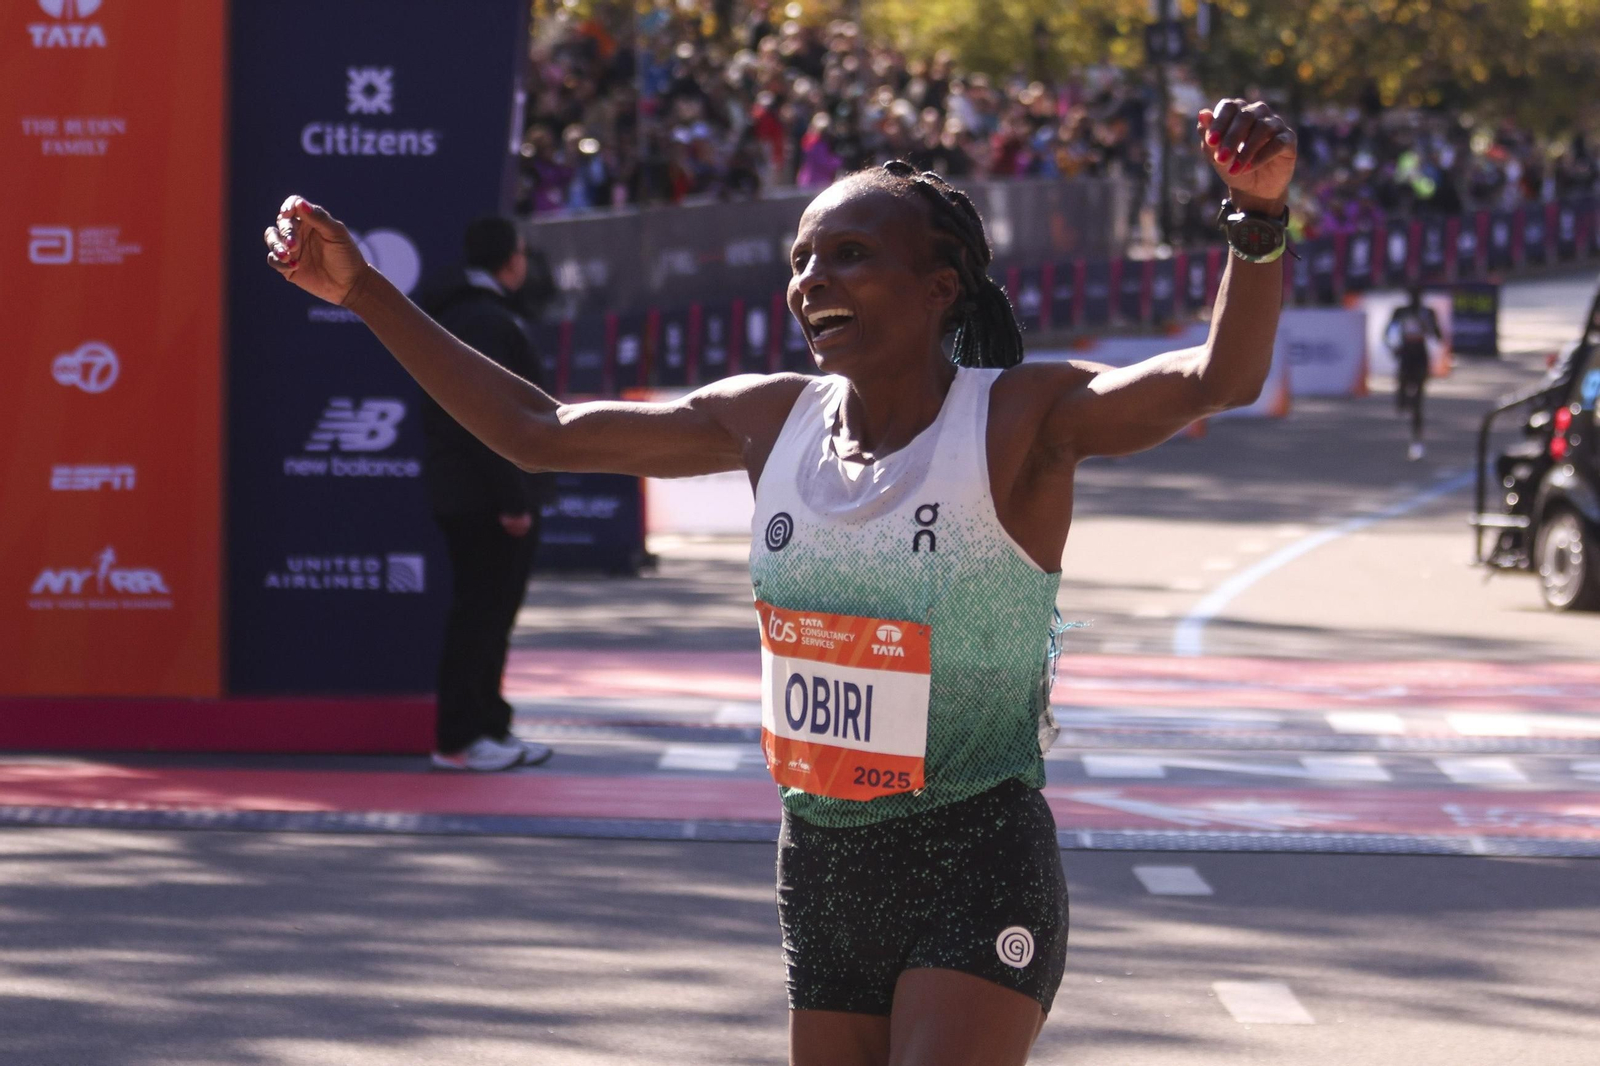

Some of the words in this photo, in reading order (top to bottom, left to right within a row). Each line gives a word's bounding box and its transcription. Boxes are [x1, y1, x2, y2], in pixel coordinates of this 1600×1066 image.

[28, 23, 106, 48] TATA
[301, 123, 437, 155] Citizens
[284, 459, 327, 476] new
[332, 457, 420, 477] balance
[51, 465, 135, 490] ESPN
[287, 556, 381, 574] UNITED
[265, 574, 381, 590] AIRLINES
[799, 618, 824, 628] TATA
[800, 627, 855, 642] CONSULTANCY
[801, 636, 835, 650] SERVICES
[871, 644, 905, 657] TATA
[785, 672, 873, 743] OBIRI
[853, 766, 911, 789] 2025
